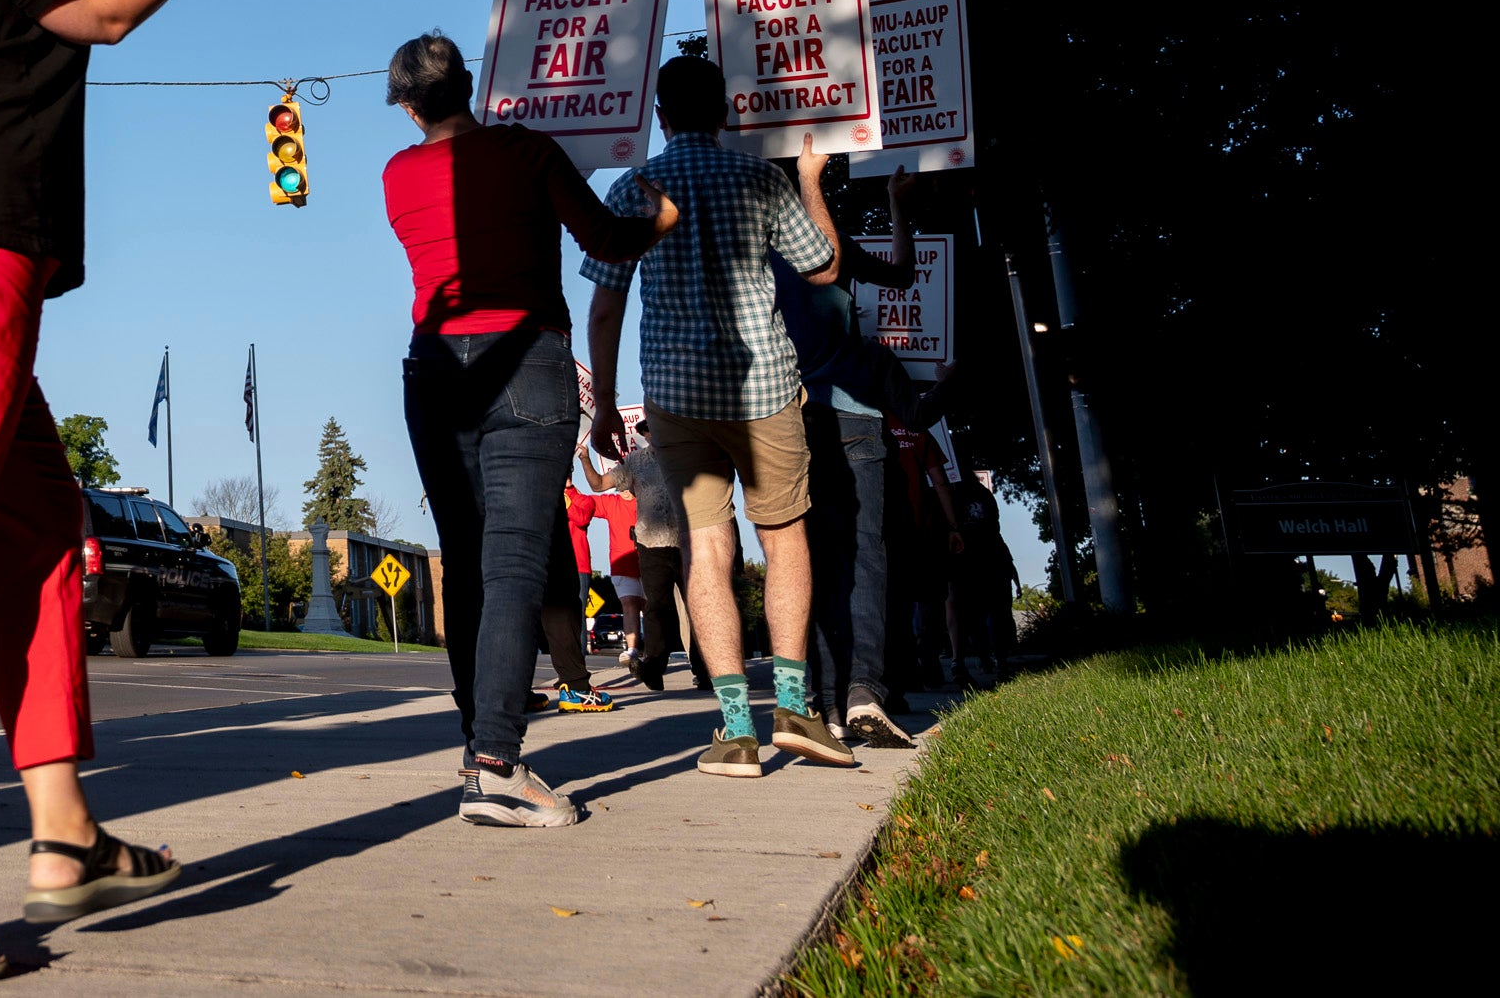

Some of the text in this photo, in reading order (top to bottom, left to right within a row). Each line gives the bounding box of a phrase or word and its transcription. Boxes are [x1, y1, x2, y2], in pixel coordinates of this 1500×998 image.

[537, 14, 610, 40] FOR A
[754, 14, 822, 40] FOR A
[872, 4, 949, 33] MU-AAUP
[529, 40, 607, 80] FAIR
[755, 37, 827, 77] FAIR
[882, 55, 934, 77] FOR A
[732, 82, 857, 115] CONTRACT
[882, 74, 936, 107] FAIR
[496, 90, 633, 121] CONTRACT
[880, 110, 958, 137] ONTRACT
[878, 288, 922, 302] FOR A
[877, 304, 922, 327] FAIR
[1278, 518, 1368, 534] Welch Hall
[156, 565, 212, 590] POLICE
